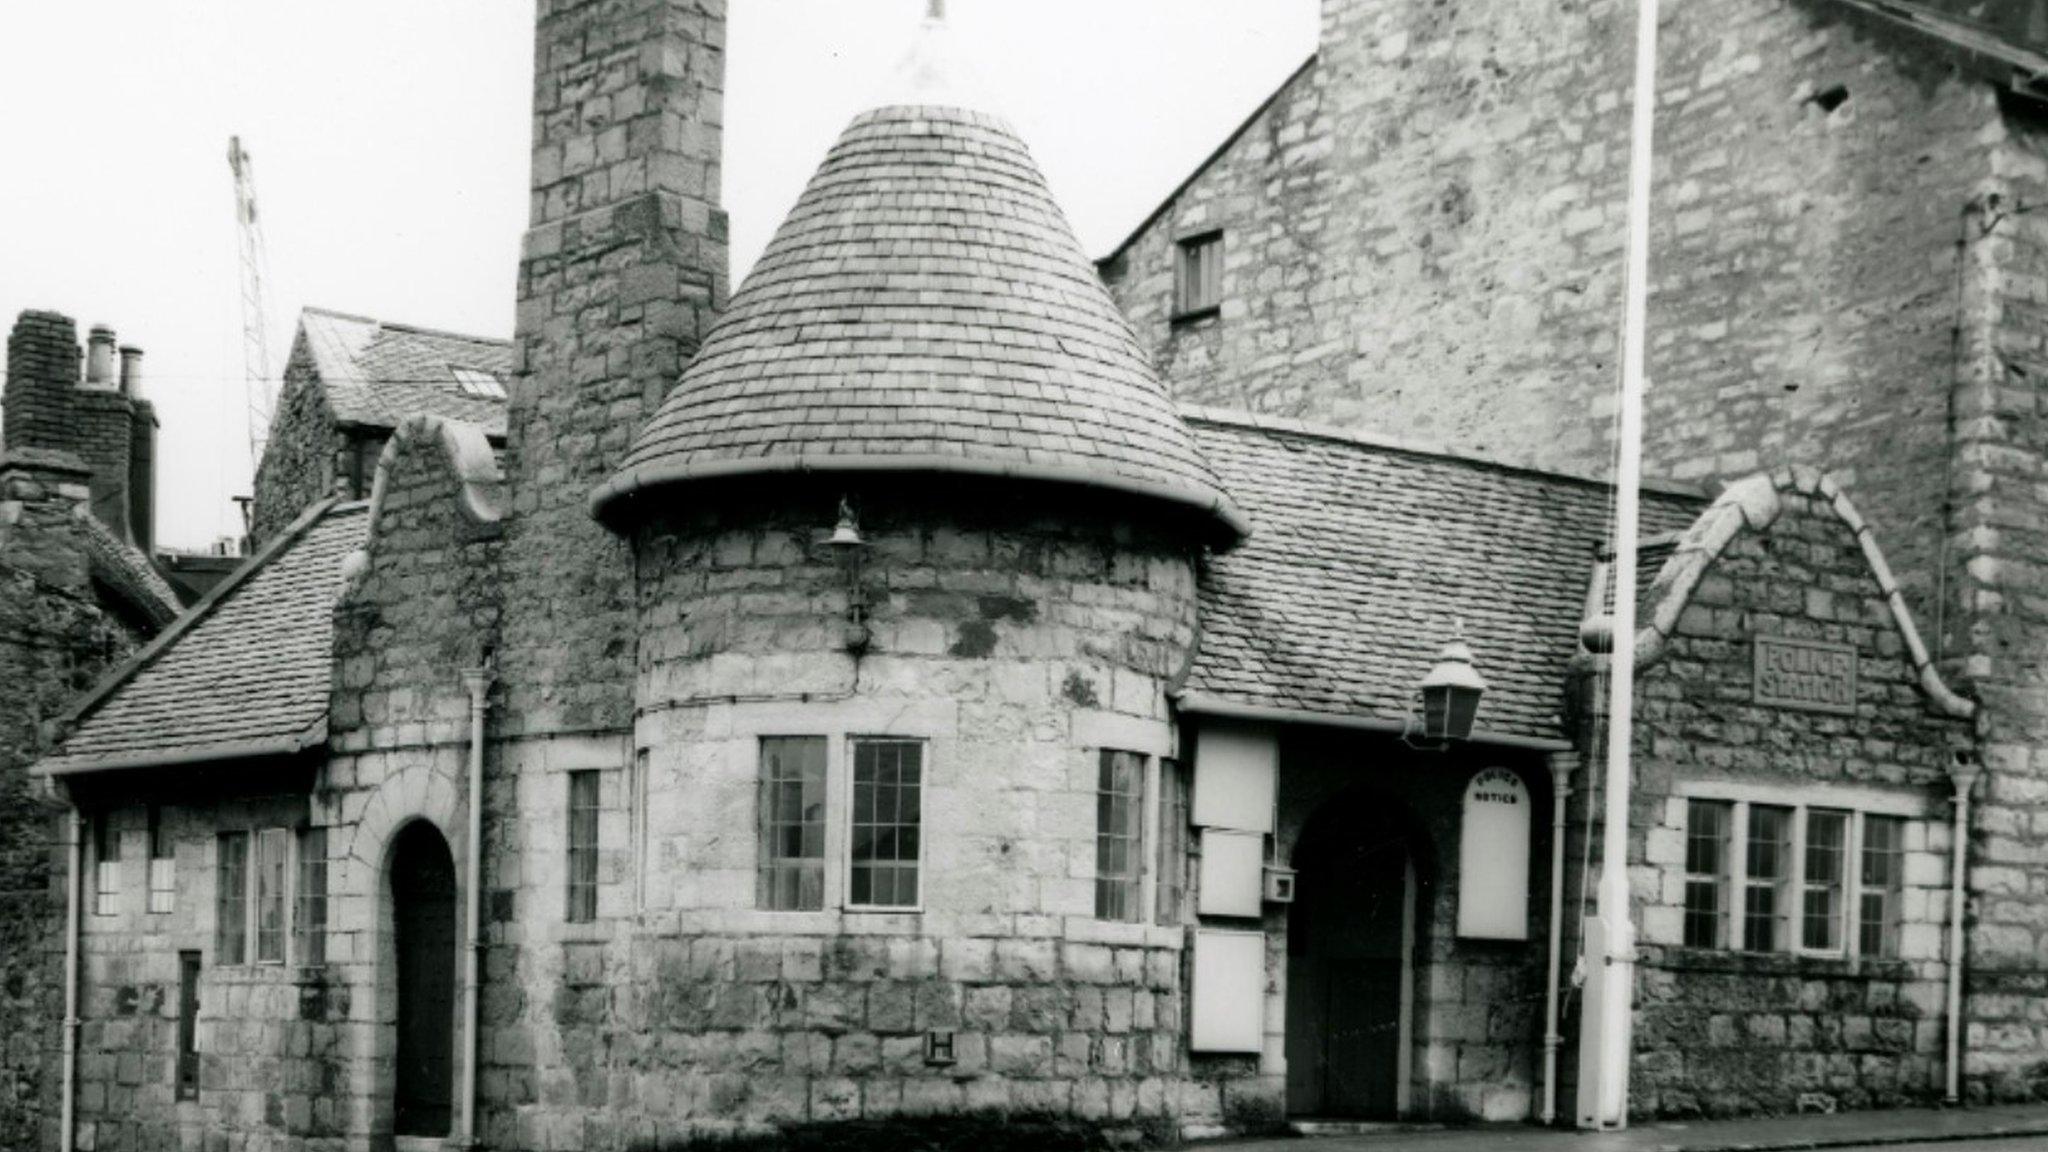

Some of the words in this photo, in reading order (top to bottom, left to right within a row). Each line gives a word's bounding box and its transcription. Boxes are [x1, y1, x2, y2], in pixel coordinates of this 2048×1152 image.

[1765, 645, 1849, 679] POLICE
[1761, 673, 1849, 705] STATION
[1476, 770, 1518, 787] POLICE
[1474, 792, 1517, 804] NOTICE
[930, 1031, 953, 1060] H
